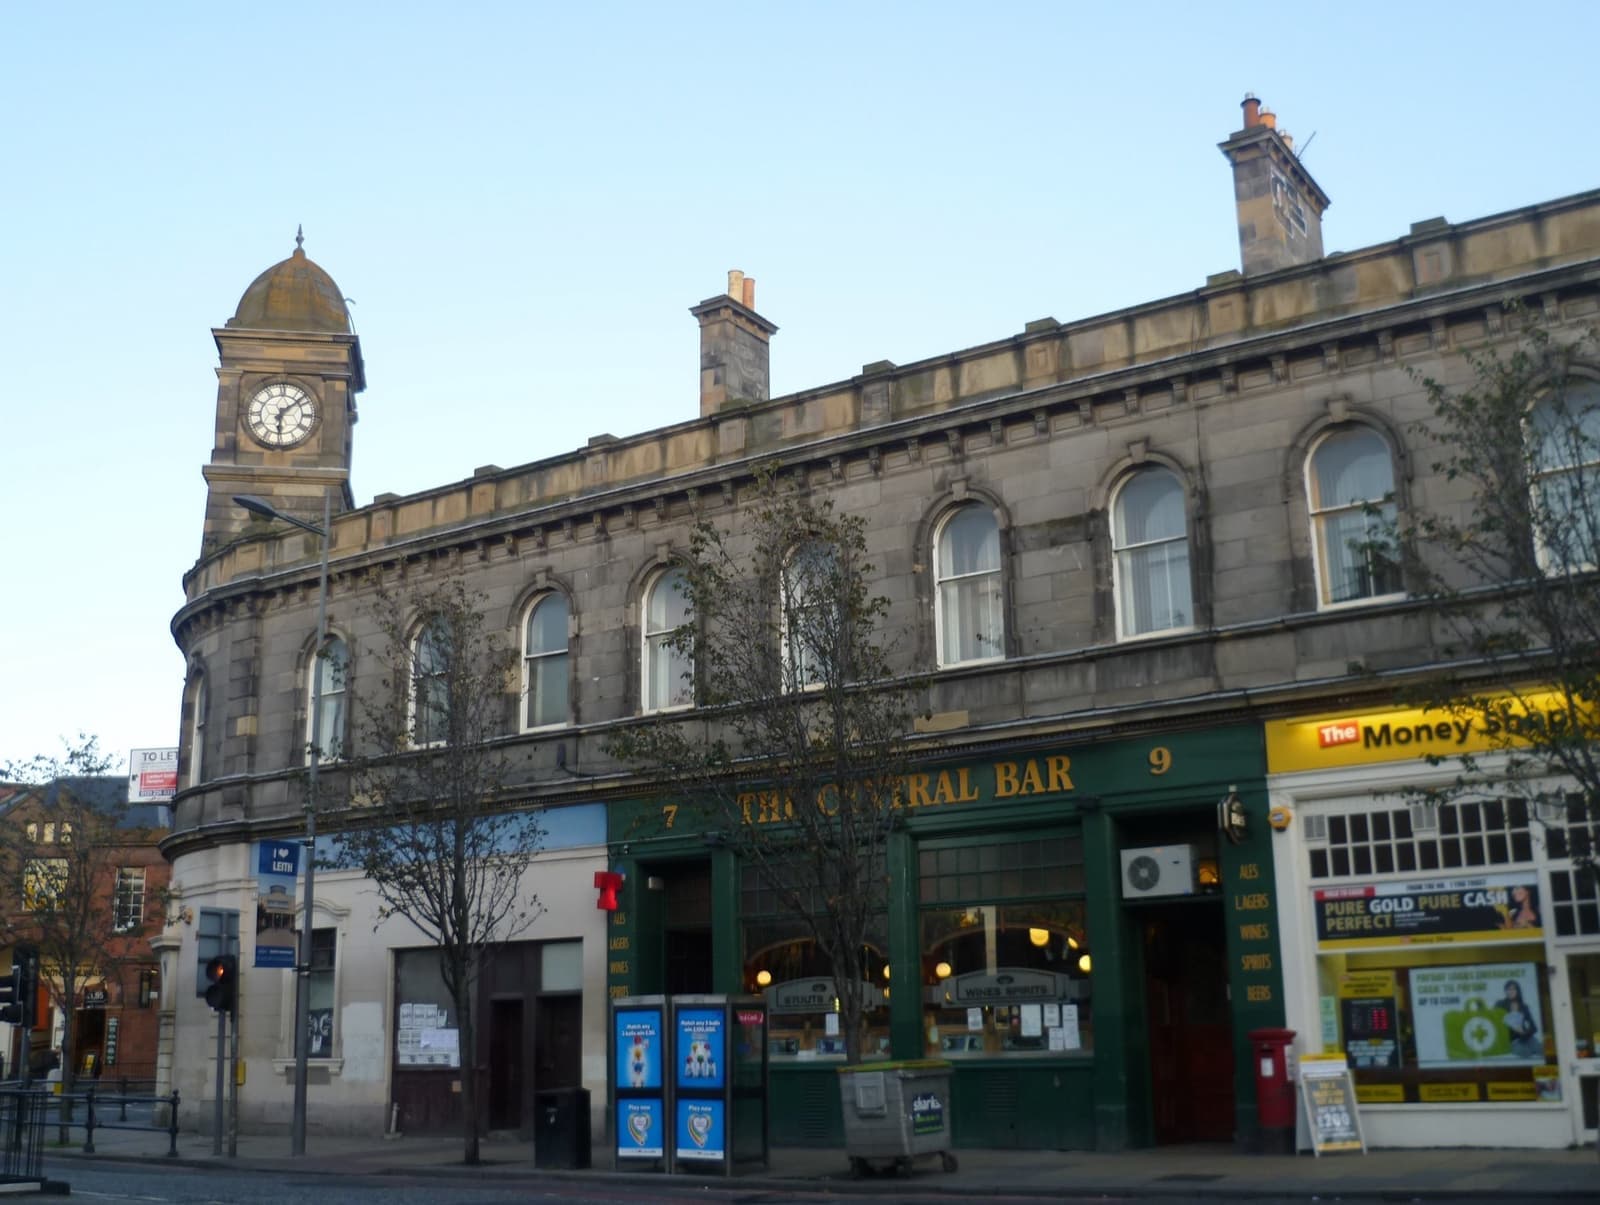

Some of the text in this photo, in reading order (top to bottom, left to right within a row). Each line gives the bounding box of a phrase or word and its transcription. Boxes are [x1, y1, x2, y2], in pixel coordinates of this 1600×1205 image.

[1320, 726, 1356, 744] The
[1362, 718, 1474, 749] Money
[142, 752, 157, 761] TO
[1148, 747, 1172, 775] 9
[816, 767, 979, 817] CTRAL
[993, 755, 1075, 798] BAR
[663, 804, 679, 829] 7
[272, 860, 294, 873] LEITH
[1239, 863, 1260, 879] ALES
[1235, 893, 1270, 910] LAGERS
[1325, 891, 1508, 917] PURE GOLD PURE CASH
[1239, 923, 1269, 940] WINES
[1326, 914, 1393, 932] PERFECT
[1241, 953, 1272, 971] SPIRITS
[965, 984, 1048, 996] WINES SPIRITS
[1247, 985, 1272, 1001] BEERS
